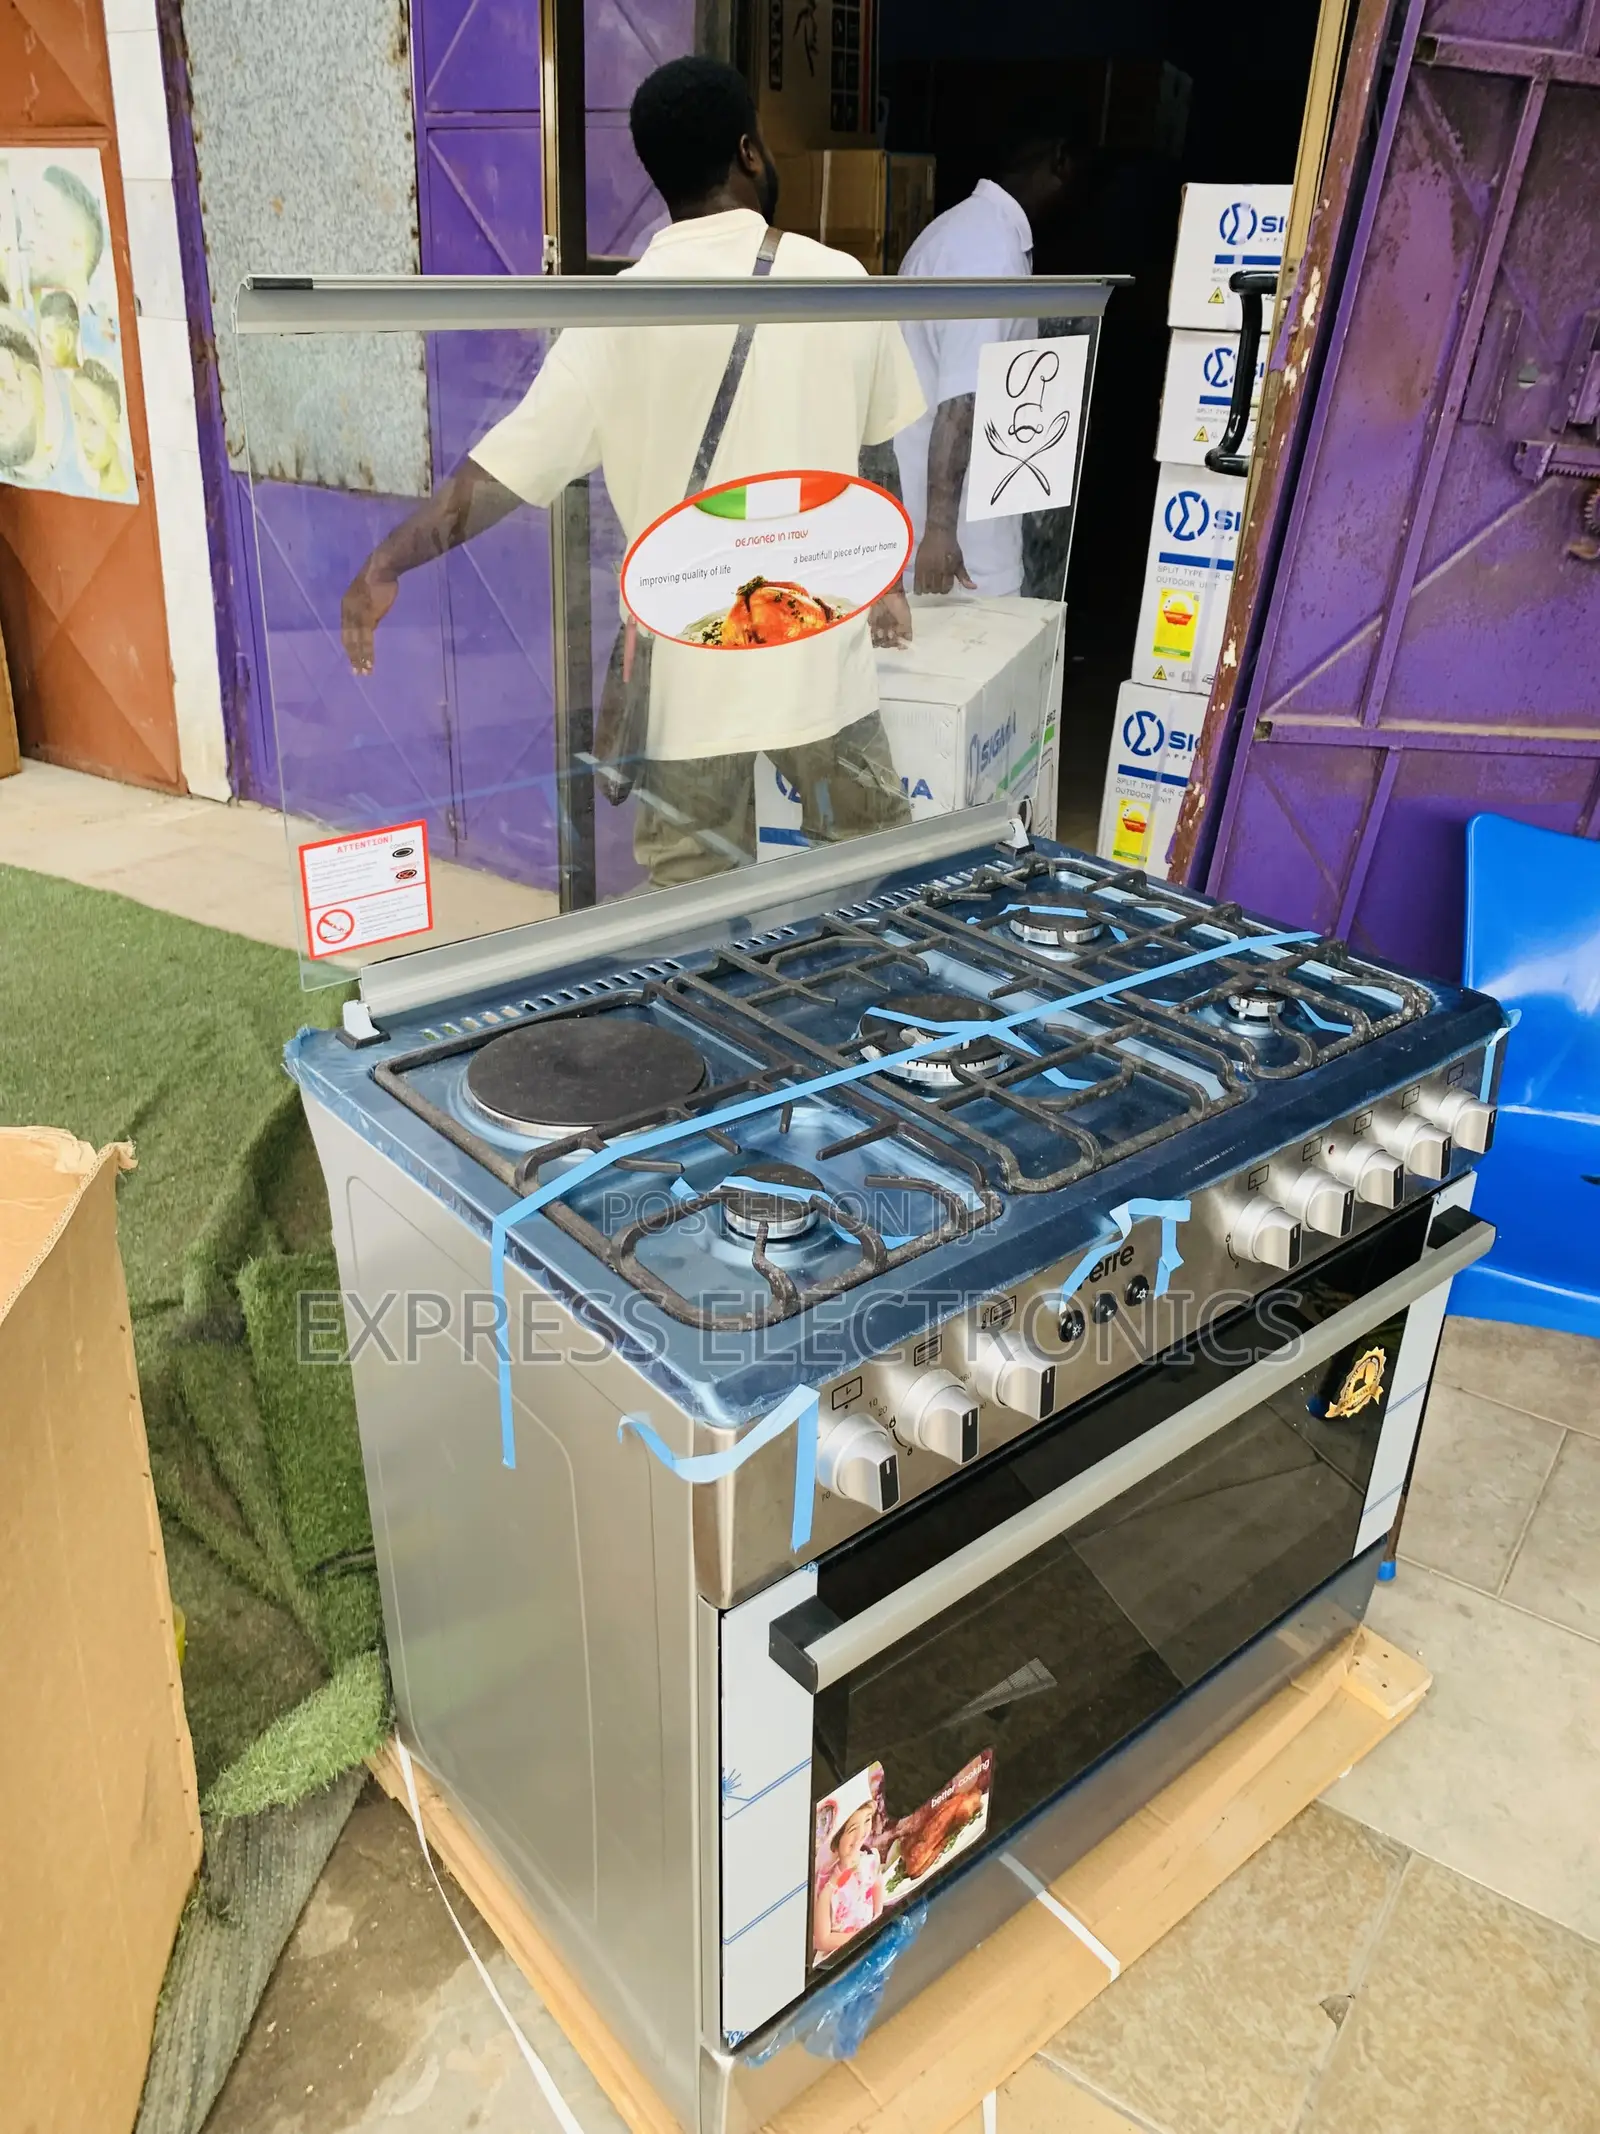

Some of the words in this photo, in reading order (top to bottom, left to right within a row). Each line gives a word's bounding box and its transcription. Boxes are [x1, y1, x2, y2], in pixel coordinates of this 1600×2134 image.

[1261, 216, 1288, 233] SI
[735, 534, 776, 548] DESIGNED
[777, 532, 786, 541] IN
[793, 556, 798, 564] a
[833, 548, 852, 560] piece
[853, 545, 861, 556] of
[861, 543, 878, 557] your
[878, 540, 898, 551] home
[639, 574, 680, 588] improving
[681, 567, 709, 582] quality
[709, 565, 719, 577] of
[719, 564, 732, 576] life
[1156, 565, 1180, 575] SPLIT
[1184, 568, 1205, 578] TYPE
[1155, 575, 1196, 588] OUTDOOR
[1116, 777, 1137, 787] SPLIT
[1140, 781, 1157, 790] TYP
[1115, 786, 1152, 800] OUTDOOR
[336, 834, 394, 854] ATTENTION!
[931, 1784, 956, 1809] better
[958, 1758, 990, 1787] cooking
